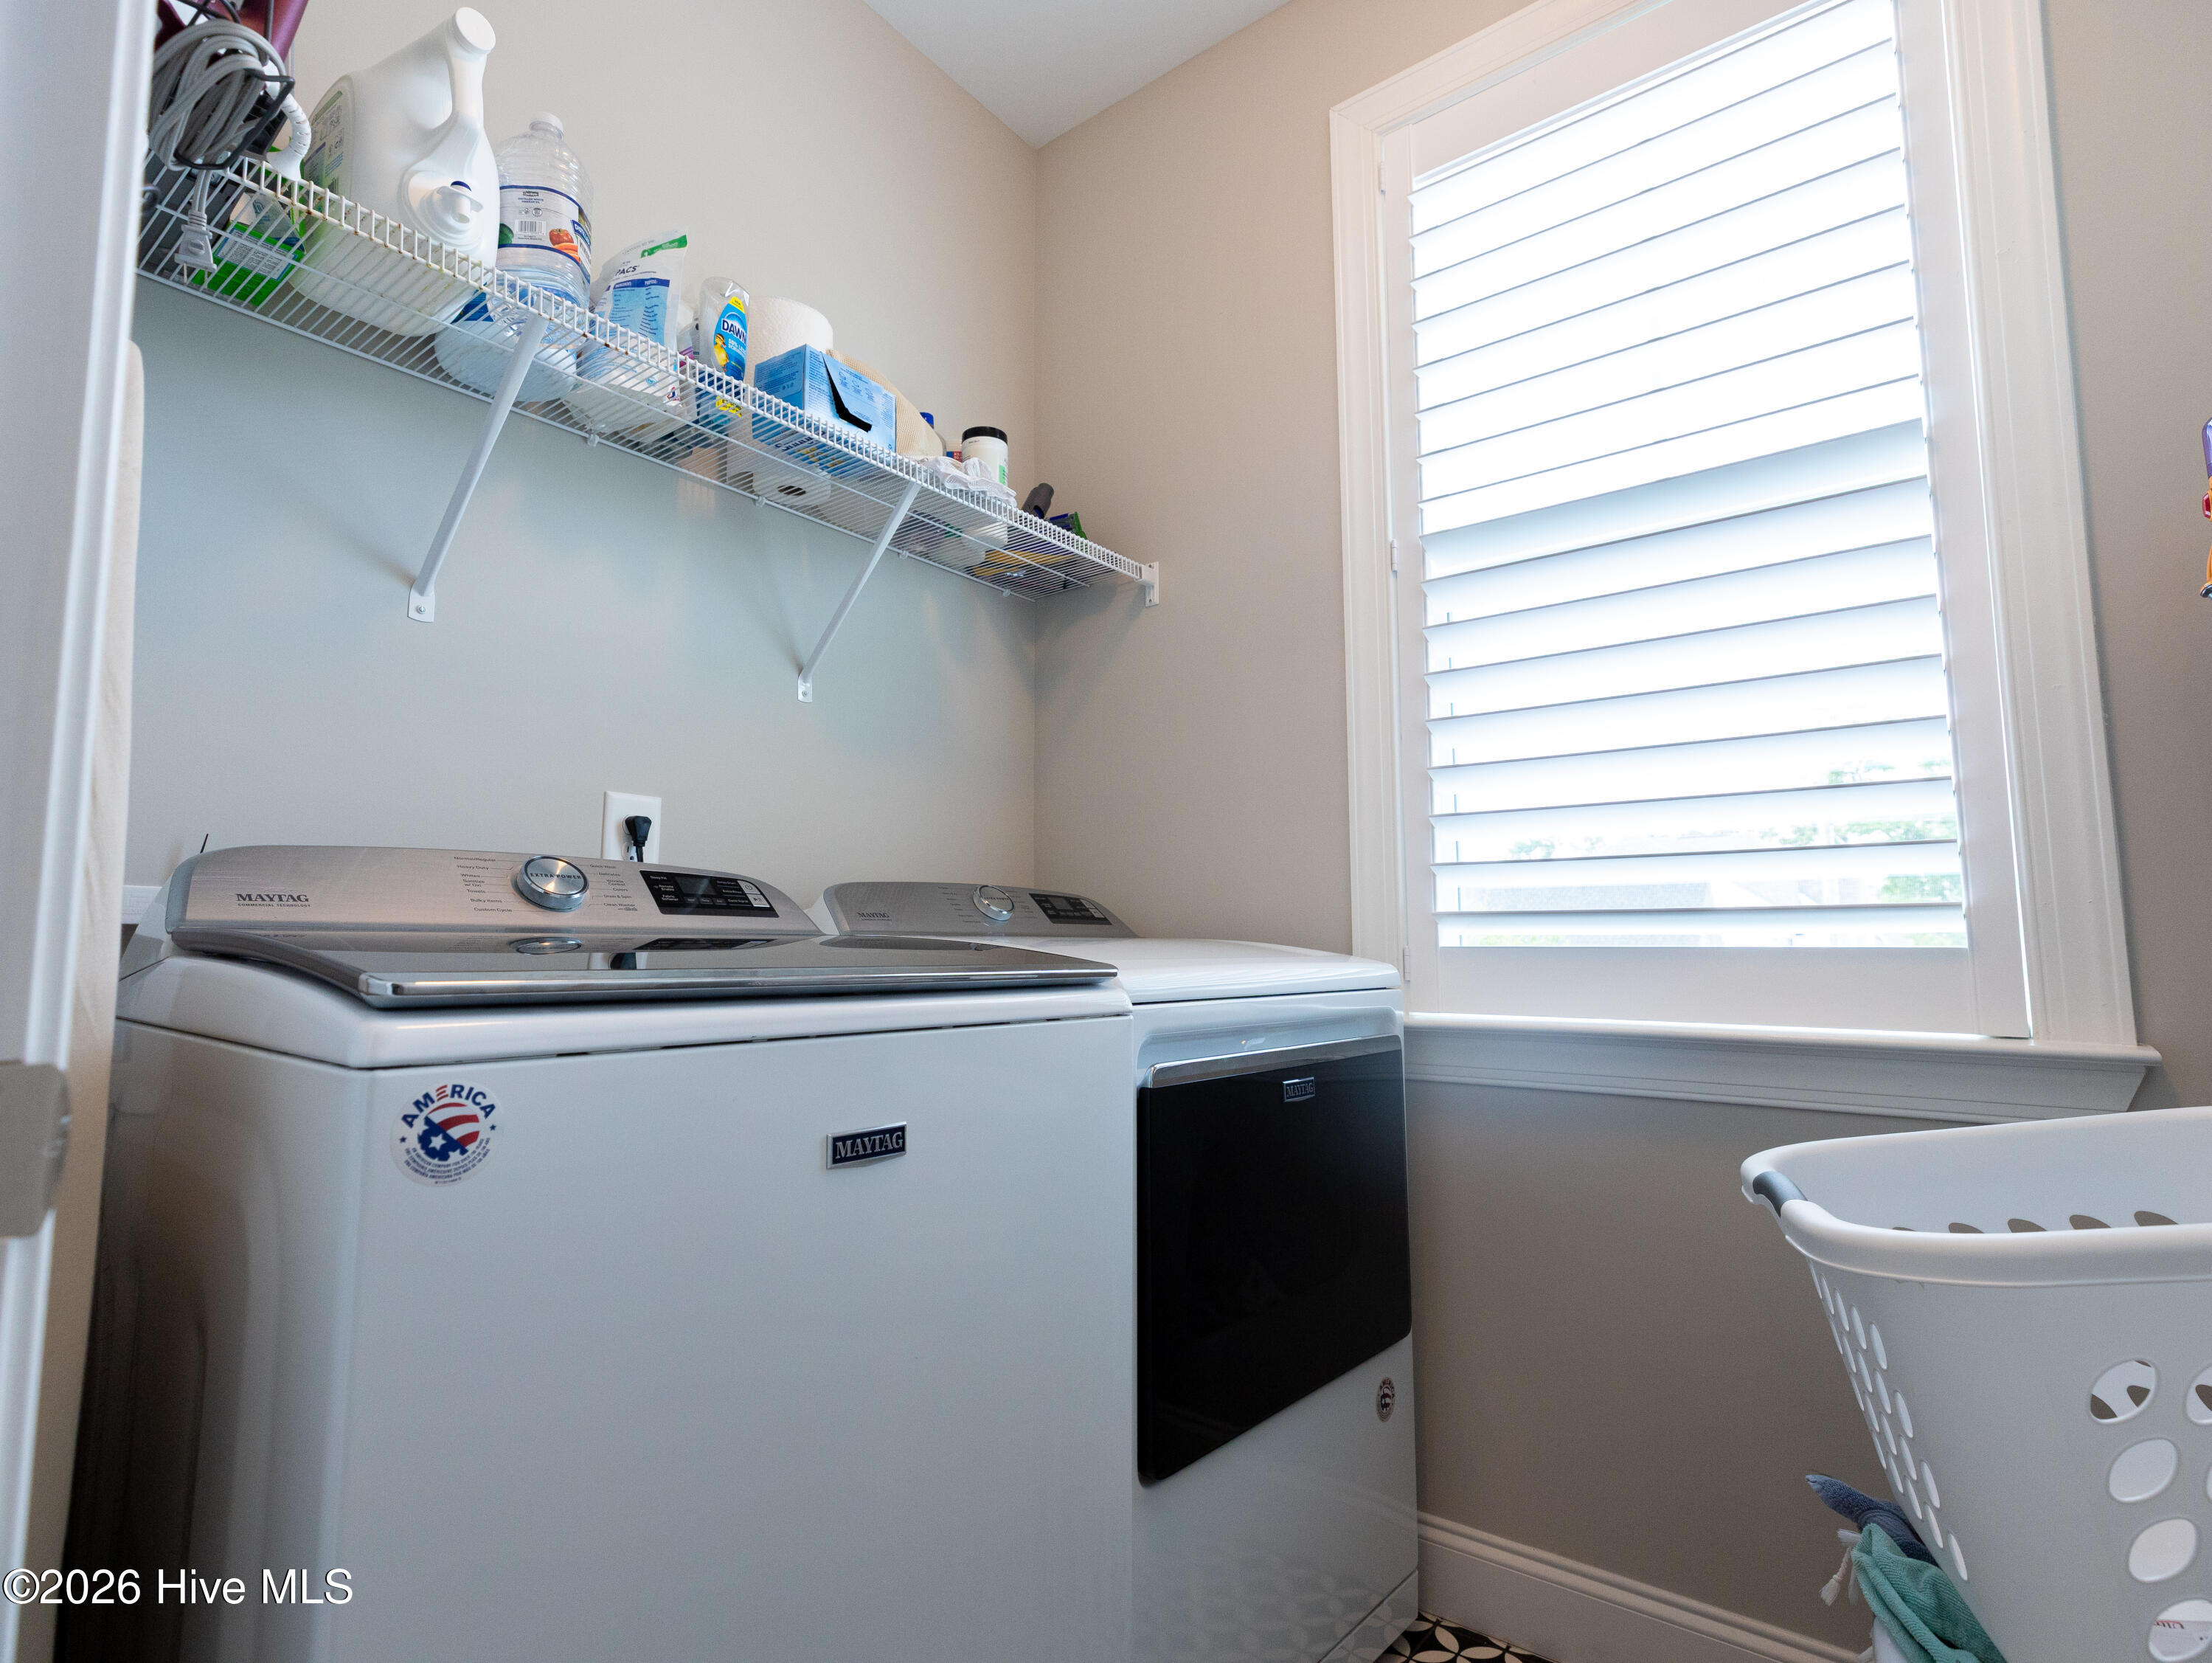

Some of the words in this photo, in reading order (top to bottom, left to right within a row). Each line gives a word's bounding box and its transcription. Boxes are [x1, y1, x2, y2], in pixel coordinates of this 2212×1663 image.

[721, 319, 746, 345] DAWN
[236, 893, 310, 902] MAYTAG
[1286, 1083, 1313, 1097] MAYTAG
[401, 1084, 496, 1129] AMERICA
[836, 1132, 904, 1159] MAYTAG
